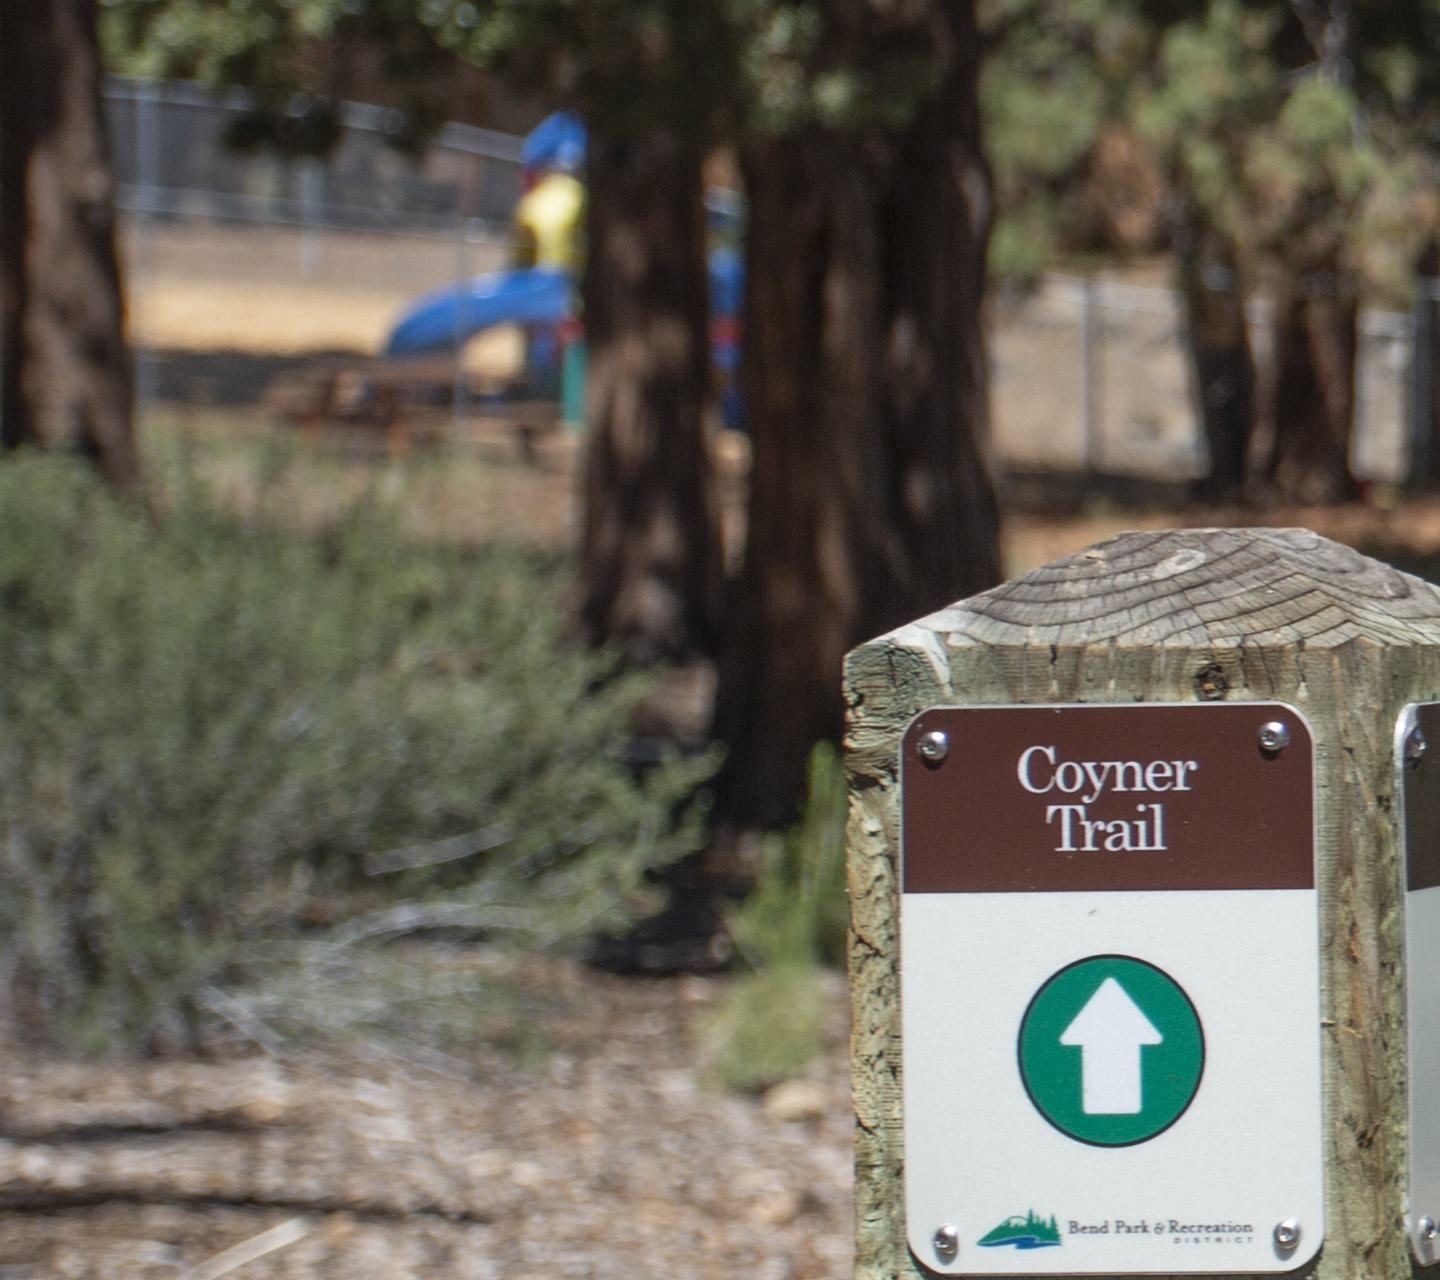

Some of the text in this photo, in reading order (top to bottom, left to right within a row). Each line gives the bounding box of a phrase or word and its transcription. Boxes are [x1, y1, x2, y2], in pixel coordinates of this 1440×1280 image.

[1016, 745, 1199, 803] Coyner
[1045, 803, 1168, 852] Trail
[1068, 1219, 1254, 1235] Bend Park & Recreation
[1173, 1236, 1253, 1244] DISTRICT
